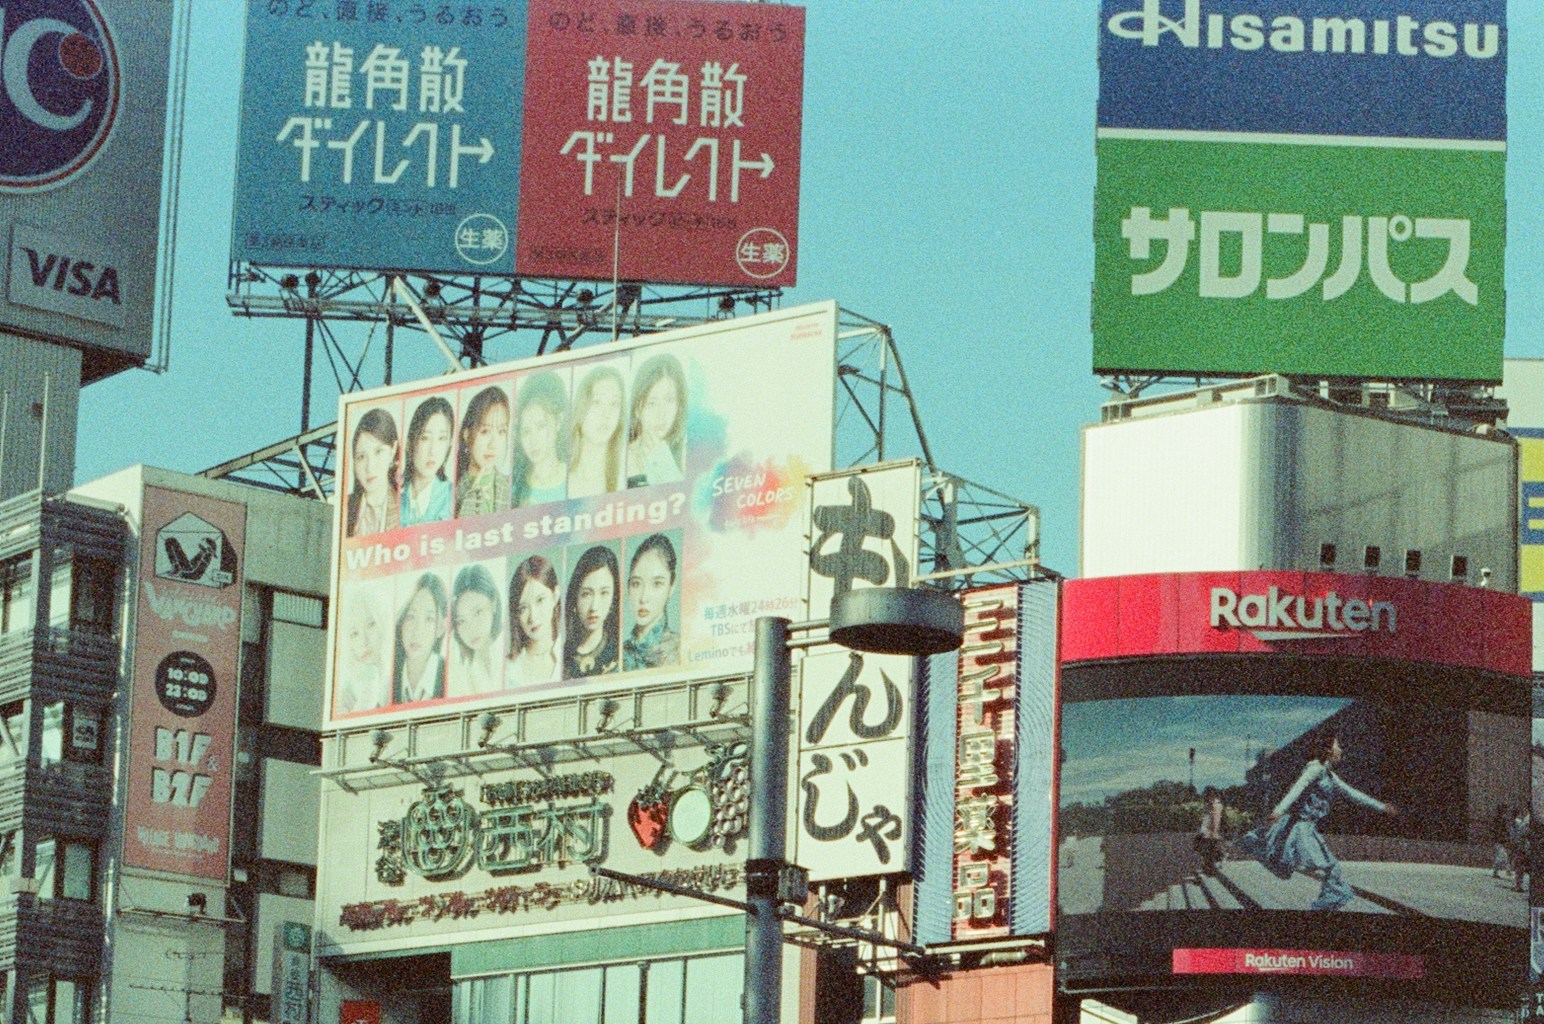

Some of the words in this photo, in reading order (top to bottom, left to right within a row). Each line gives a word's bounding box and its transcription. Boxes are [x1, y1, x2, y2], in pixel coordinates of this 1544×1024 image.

[1108, 0, 1498, 59] Hisamitsu
[303, 41, 470, 113] 龍角散
[586, 55, 748, 129] 龍角散
[276, 115, 496, 190] ダイレクト
[559, 130, 776, 204] ダイレクト
[22, 247, 122, 305] VISA
[740, 241, 786, 266] 生薬
[1121, 206, 1480, 306] サロンパス
[711, 472, 768, 498] SEVEN
[735, 486, 794, 509] COLORS
[345, 540, 411, 572] Who
[419, 534, 446, 556] is
[454, 521, 513, 550] last
[522, 492, 686, 540] standing?
[1208, 586, 1398, 636] Rakuten
[478, 800, 612, 870] 西村
[1245, 953, 1306, 972] Rakuten
[1309, 954, 1353, 971] Vision
